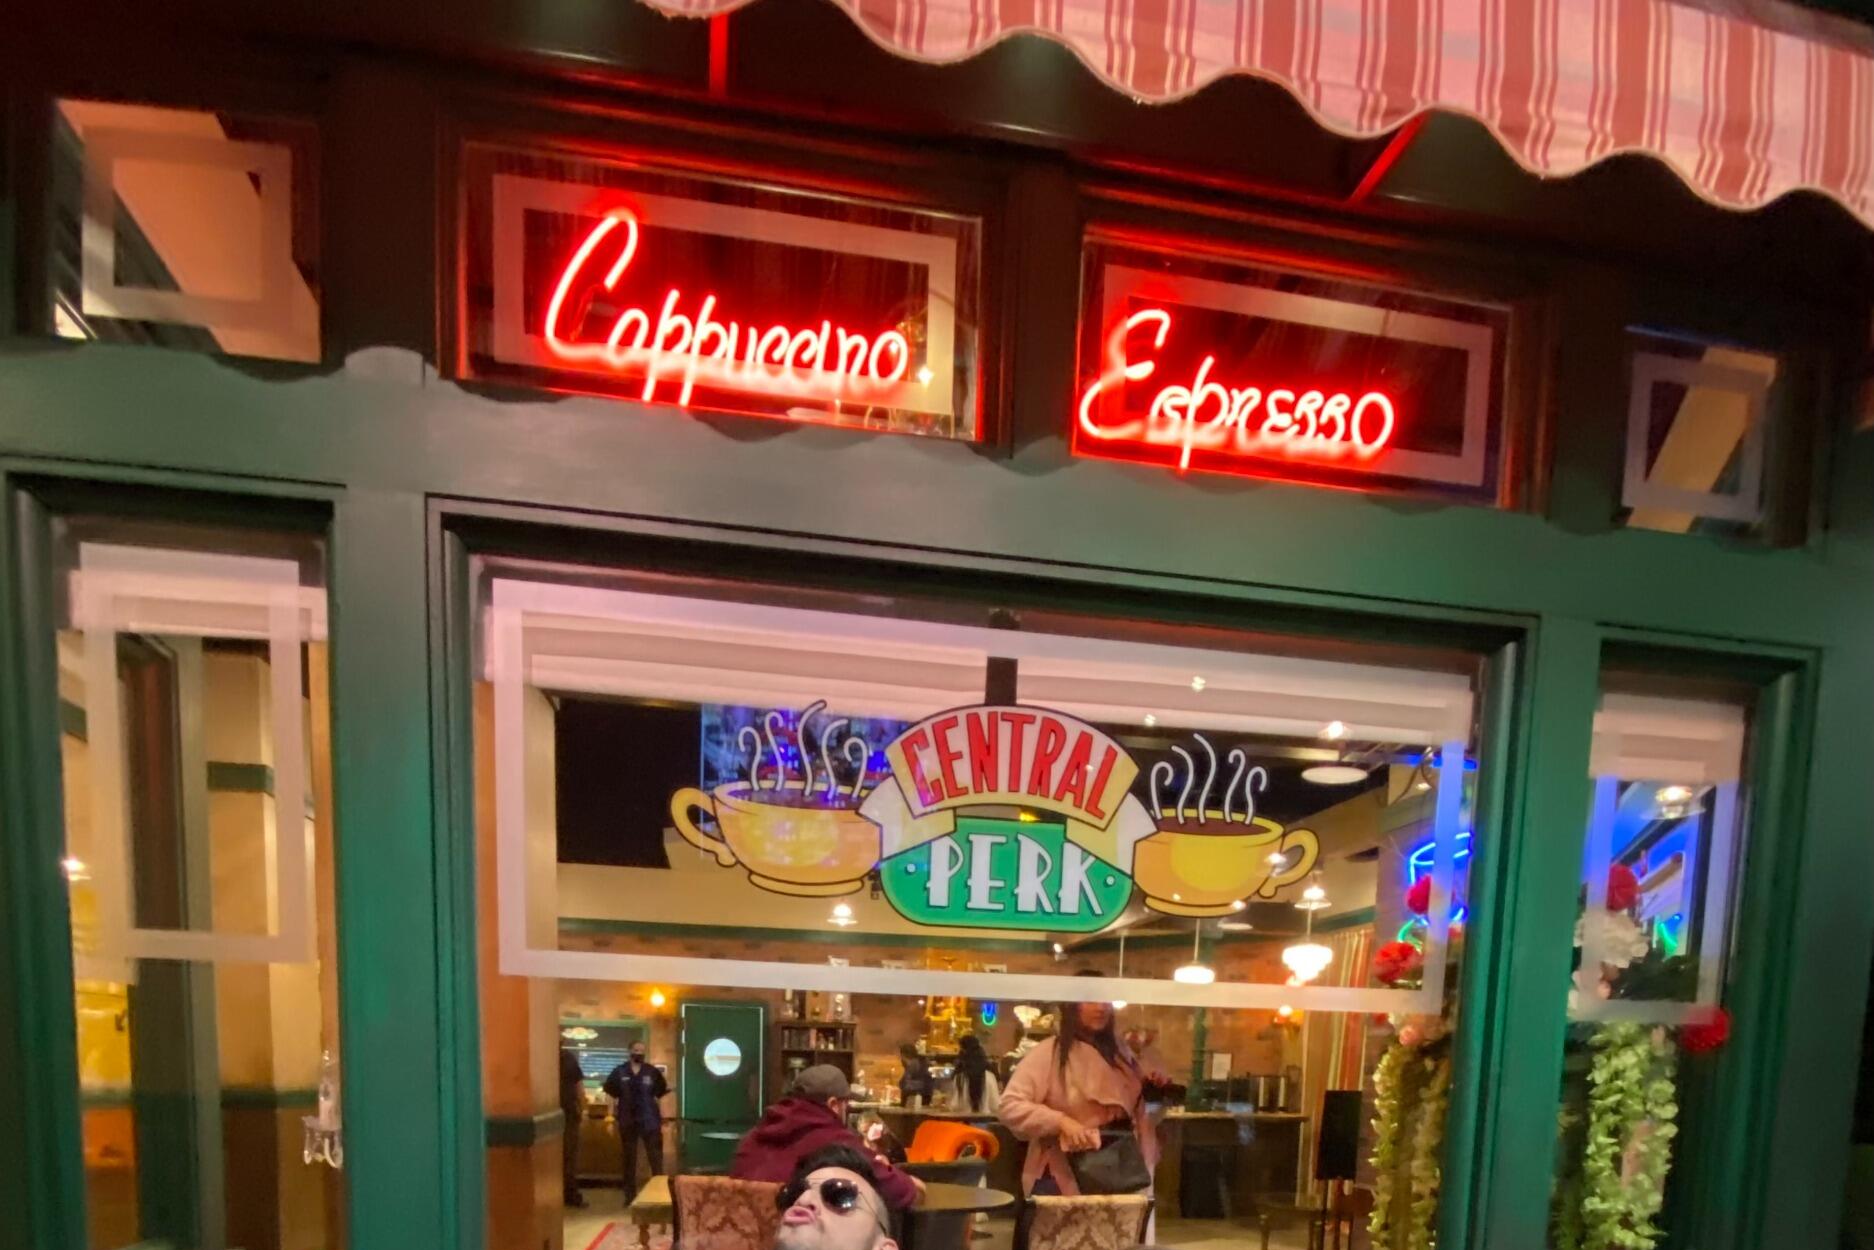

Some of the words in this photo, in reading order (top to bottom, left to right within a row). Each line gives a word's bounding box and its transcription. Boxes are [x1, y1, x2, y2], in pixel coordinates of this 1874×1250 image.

[545, 208, 908, 406] Cappuccino
[1080, 309, 1395, 470] Espresso
[900, 711, 1118, 820] CENTRAL
[926, 833, 1103, 915] PERK
